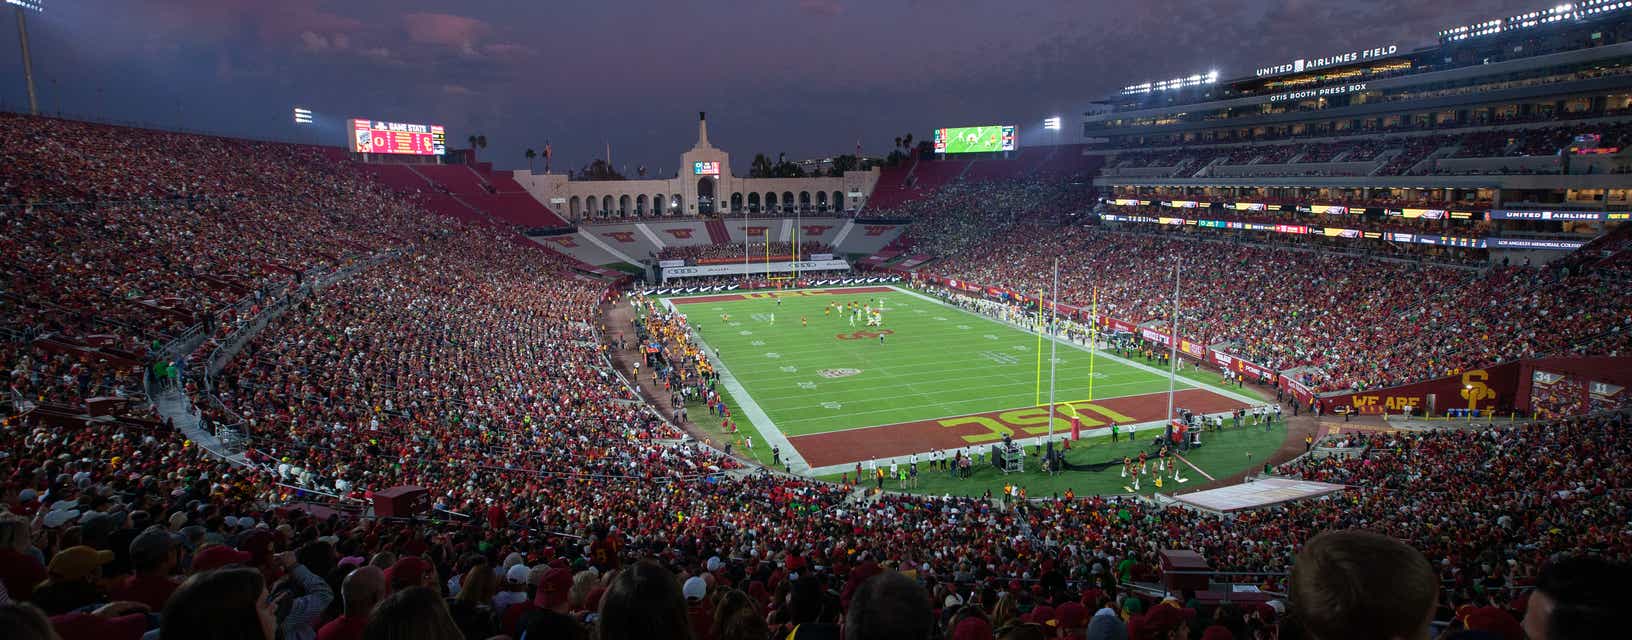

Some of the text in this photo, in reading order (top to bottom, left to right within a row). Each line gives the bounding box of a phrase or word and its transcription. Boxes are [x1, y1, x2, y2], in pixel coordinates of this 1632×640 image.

[1256, 45, 1397, 77] UNITED AIRLINES FIELD
[1290, 91, 1317, 99] BOOTH
[1320, 87, 1346, 95] PRESS
[1349, 83, 1367, 92] BOX
[1535, 371, 1608, 393] 34 11
[1352, 395, 1420, 410] WE ARE
[937, 403, 1136, 443] USC
